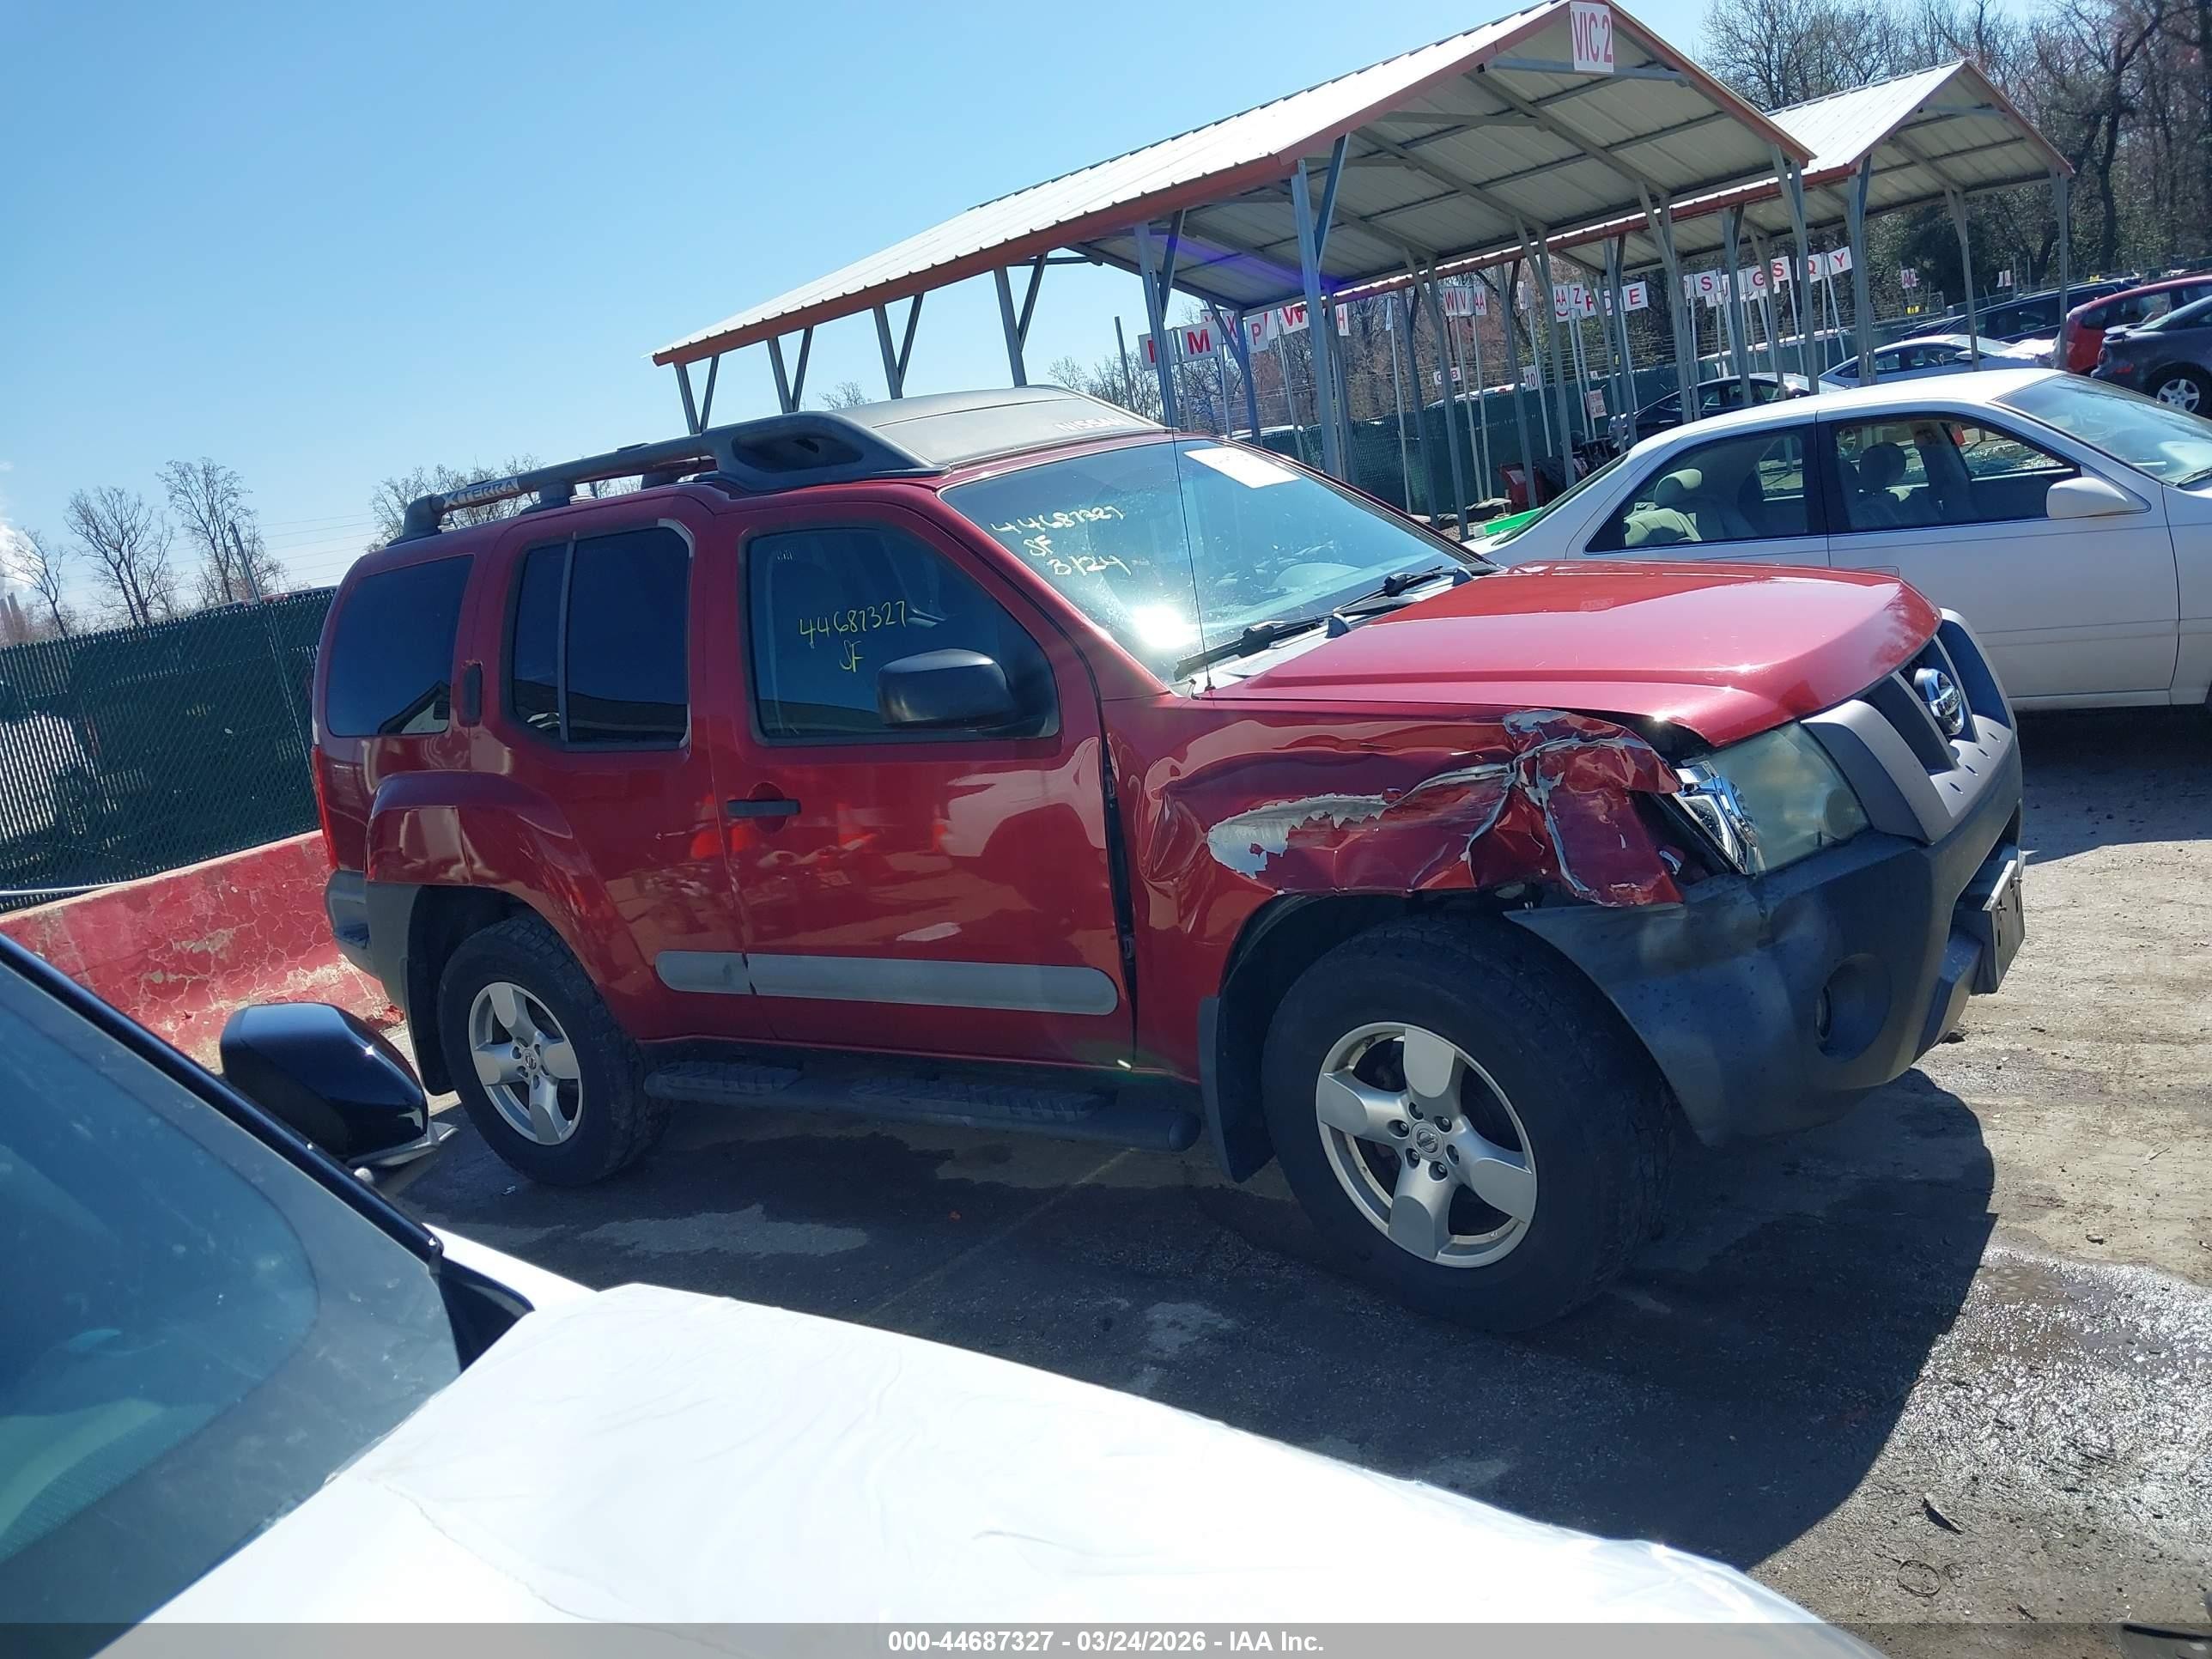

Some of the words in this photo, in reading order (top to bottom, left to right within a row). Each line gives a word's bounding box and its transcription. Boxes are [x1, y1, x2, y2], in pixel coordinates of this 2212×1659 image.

[1571, 11, 1599, 62] VIC
[1602, 15, 1613, 63] 2
[1772, 262, 1784, 276] S
[1833, 252, 1845, 268] Y
[1700, 276, 1712, 291] S
[1573, 288, 1581, 304] Z
[1629, 288, 1642, 305] E
[1187, 329, 1212, 355] M
[1250, 321, 1261, 346] P
[441, 477, 520, 509] XTERRA
[799, 600, 907, 649] 44687327
